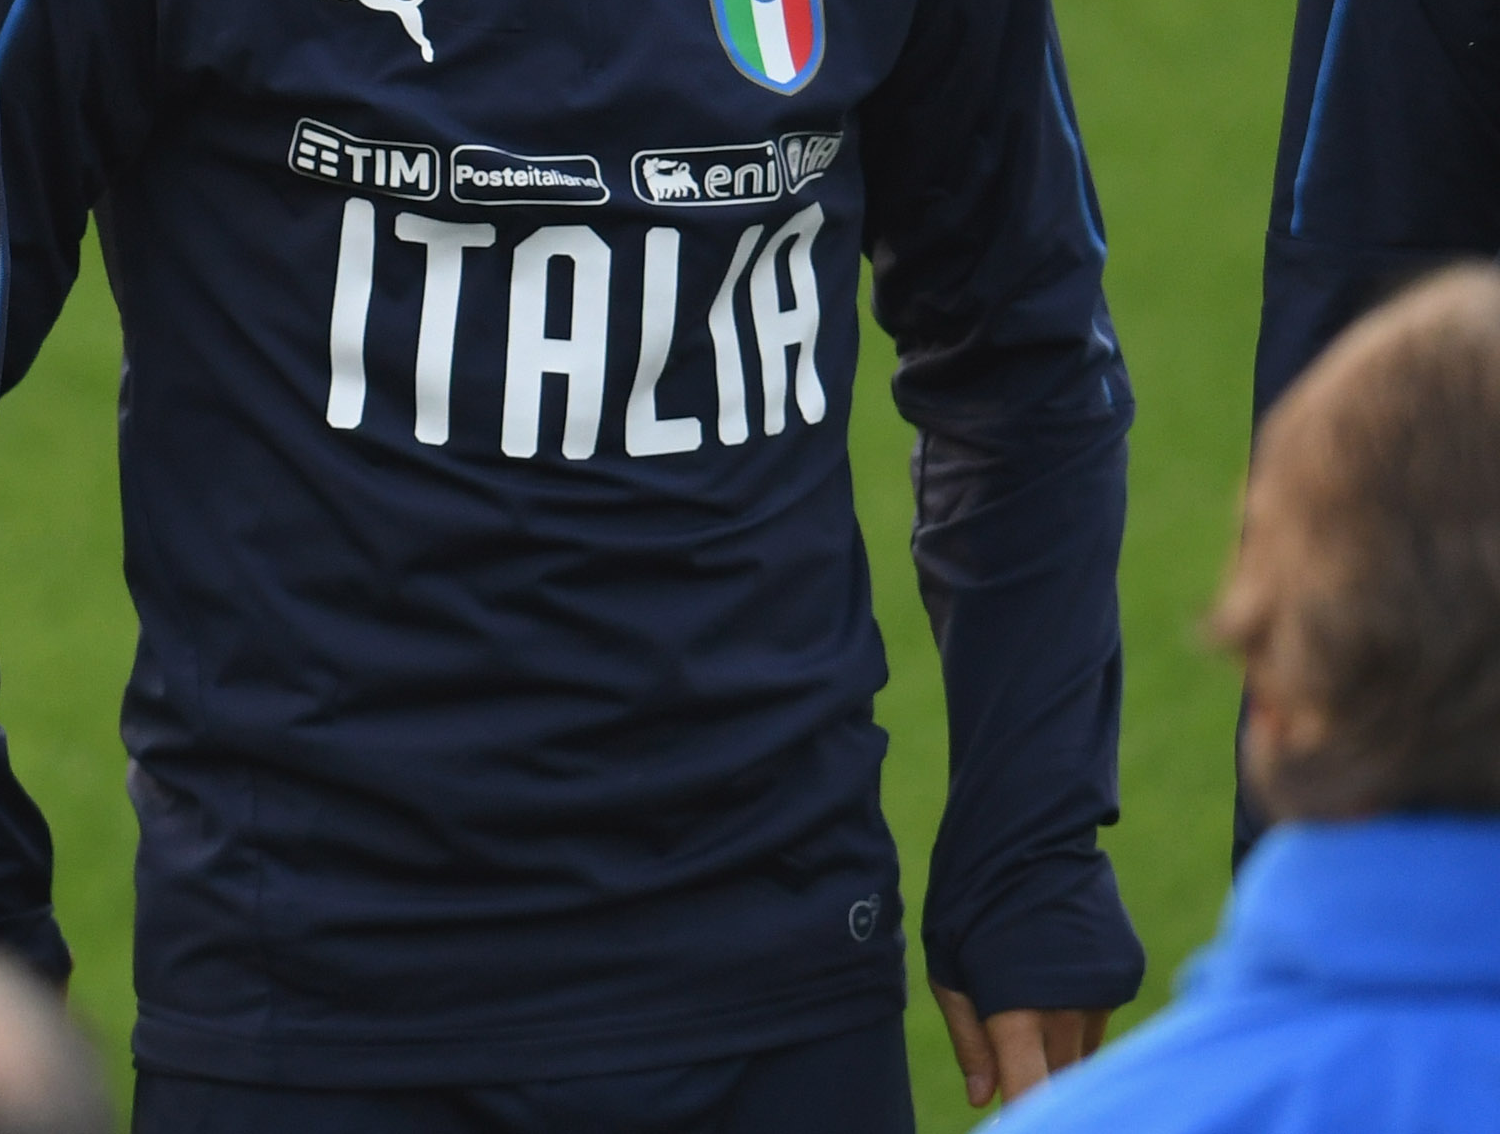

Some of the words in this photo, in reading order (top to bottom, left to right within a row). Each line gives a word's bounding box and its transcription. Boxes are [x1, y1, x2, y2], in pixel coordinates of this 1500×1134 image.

[344, 144, 430, 191] TIM
[456, 165, 600, 188] Posteitaliane
[704, 146, 776, 198] eni
[326, 197, 826, 459] ITALIA
